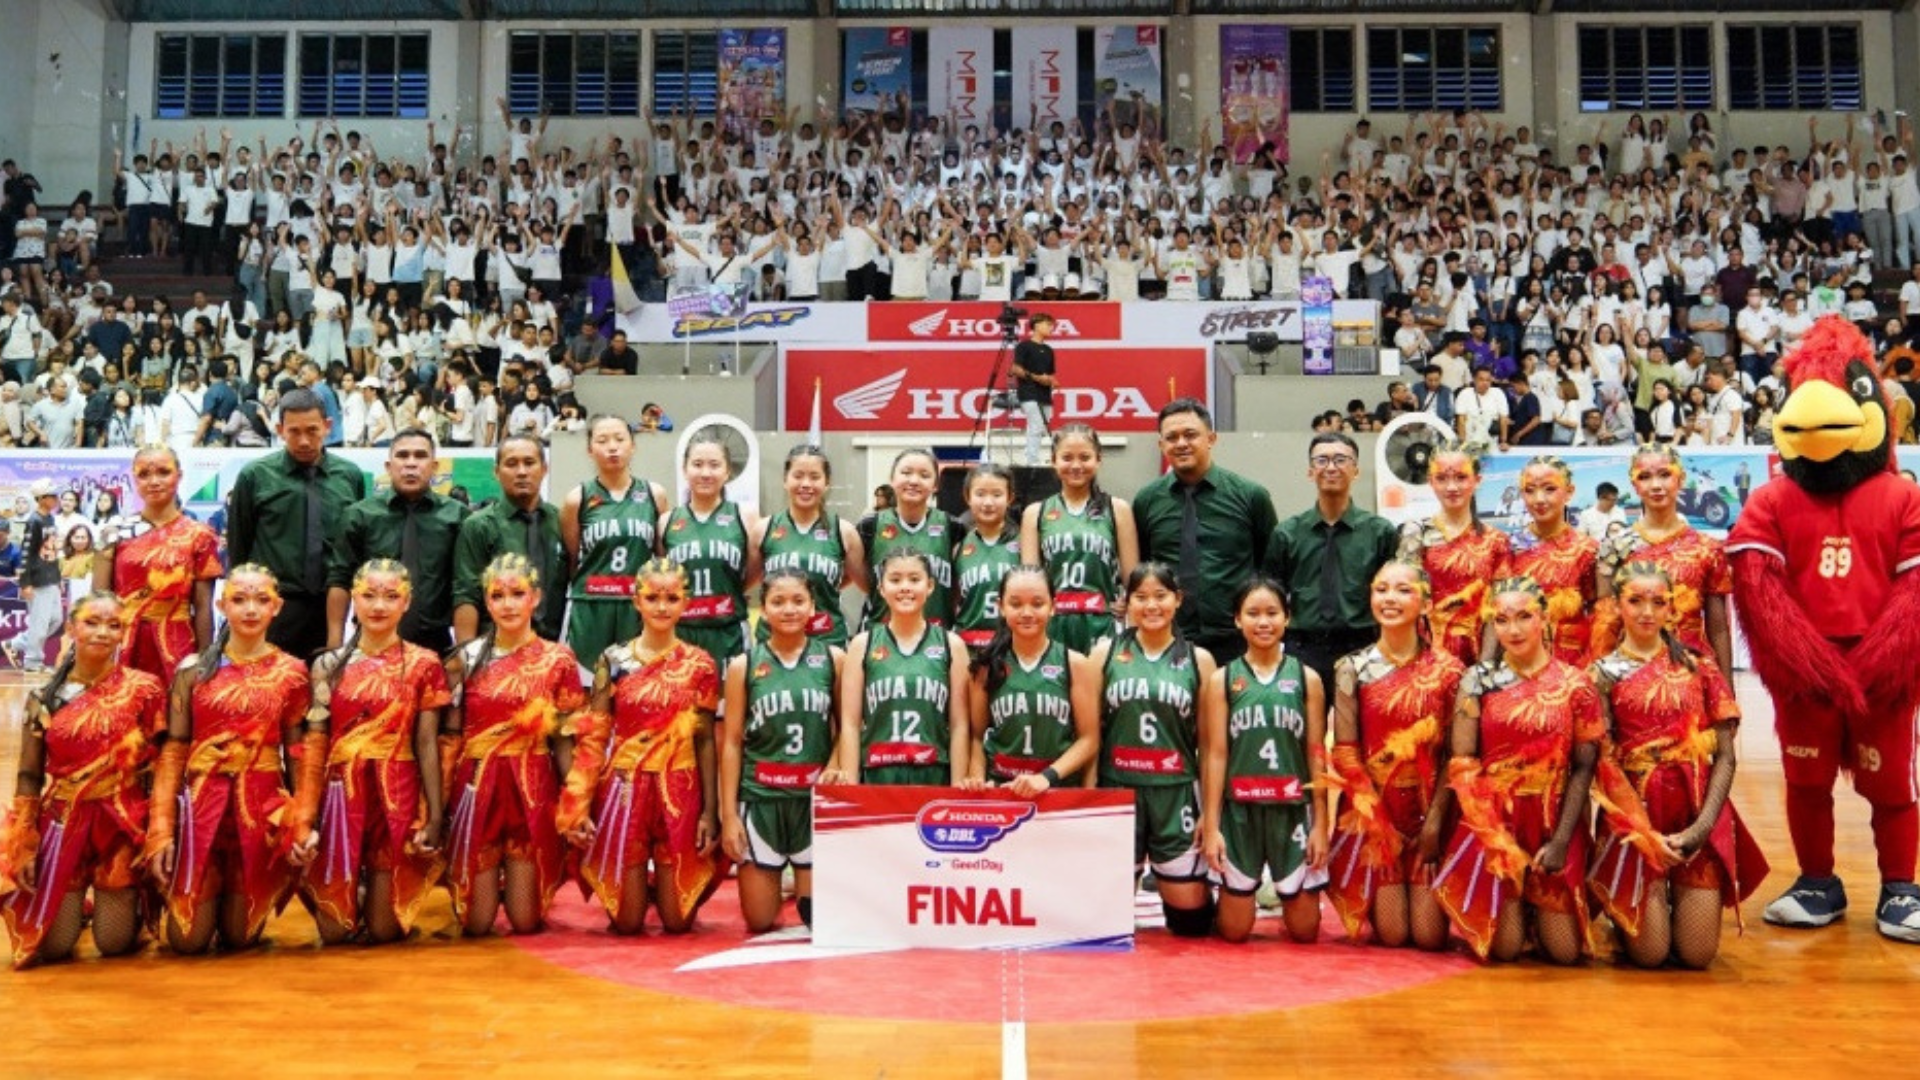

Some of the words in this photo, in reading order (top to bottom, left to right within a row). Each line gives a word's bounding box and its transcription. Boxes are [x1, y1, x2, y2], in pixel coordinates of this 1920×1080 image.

[957, 51, 976, 119] MPM
[1040, 51, 1060, 119] MPM
[1200, 307, 1297, 337] STREET
[611, 547, 628, 572] 8
[709, 540, 741, 571] IND
[808, 552, 839, 586] IND
[1819, 546, 1852, 578] 89
[694, 568, 713, 596] 11
[1060, 562, 1085, 588] 10
[984, 590, 999, 619] 5
[866, 676, 907, 714] HUA
[916, 676, 948, 713] IND
[990, 691, 1028, 726] HUA
[1037, 693, 1070, 725] IND
[786, 723, 804, 755] 3
[891, 711, 921, 742] 12
[1023, 725, 1033, 754] 1
[1139, 712, 1157, 744] 6
[1259, 739, 1279, 769] 4
[949, 812, 1007, 823] HONDA
[1181, 806, 1194, 833] 6
[948, 828, 977, 842] DBL
[1292, 823, 1307, 850] 4
[907, 885, 1036, 926] FINAL
